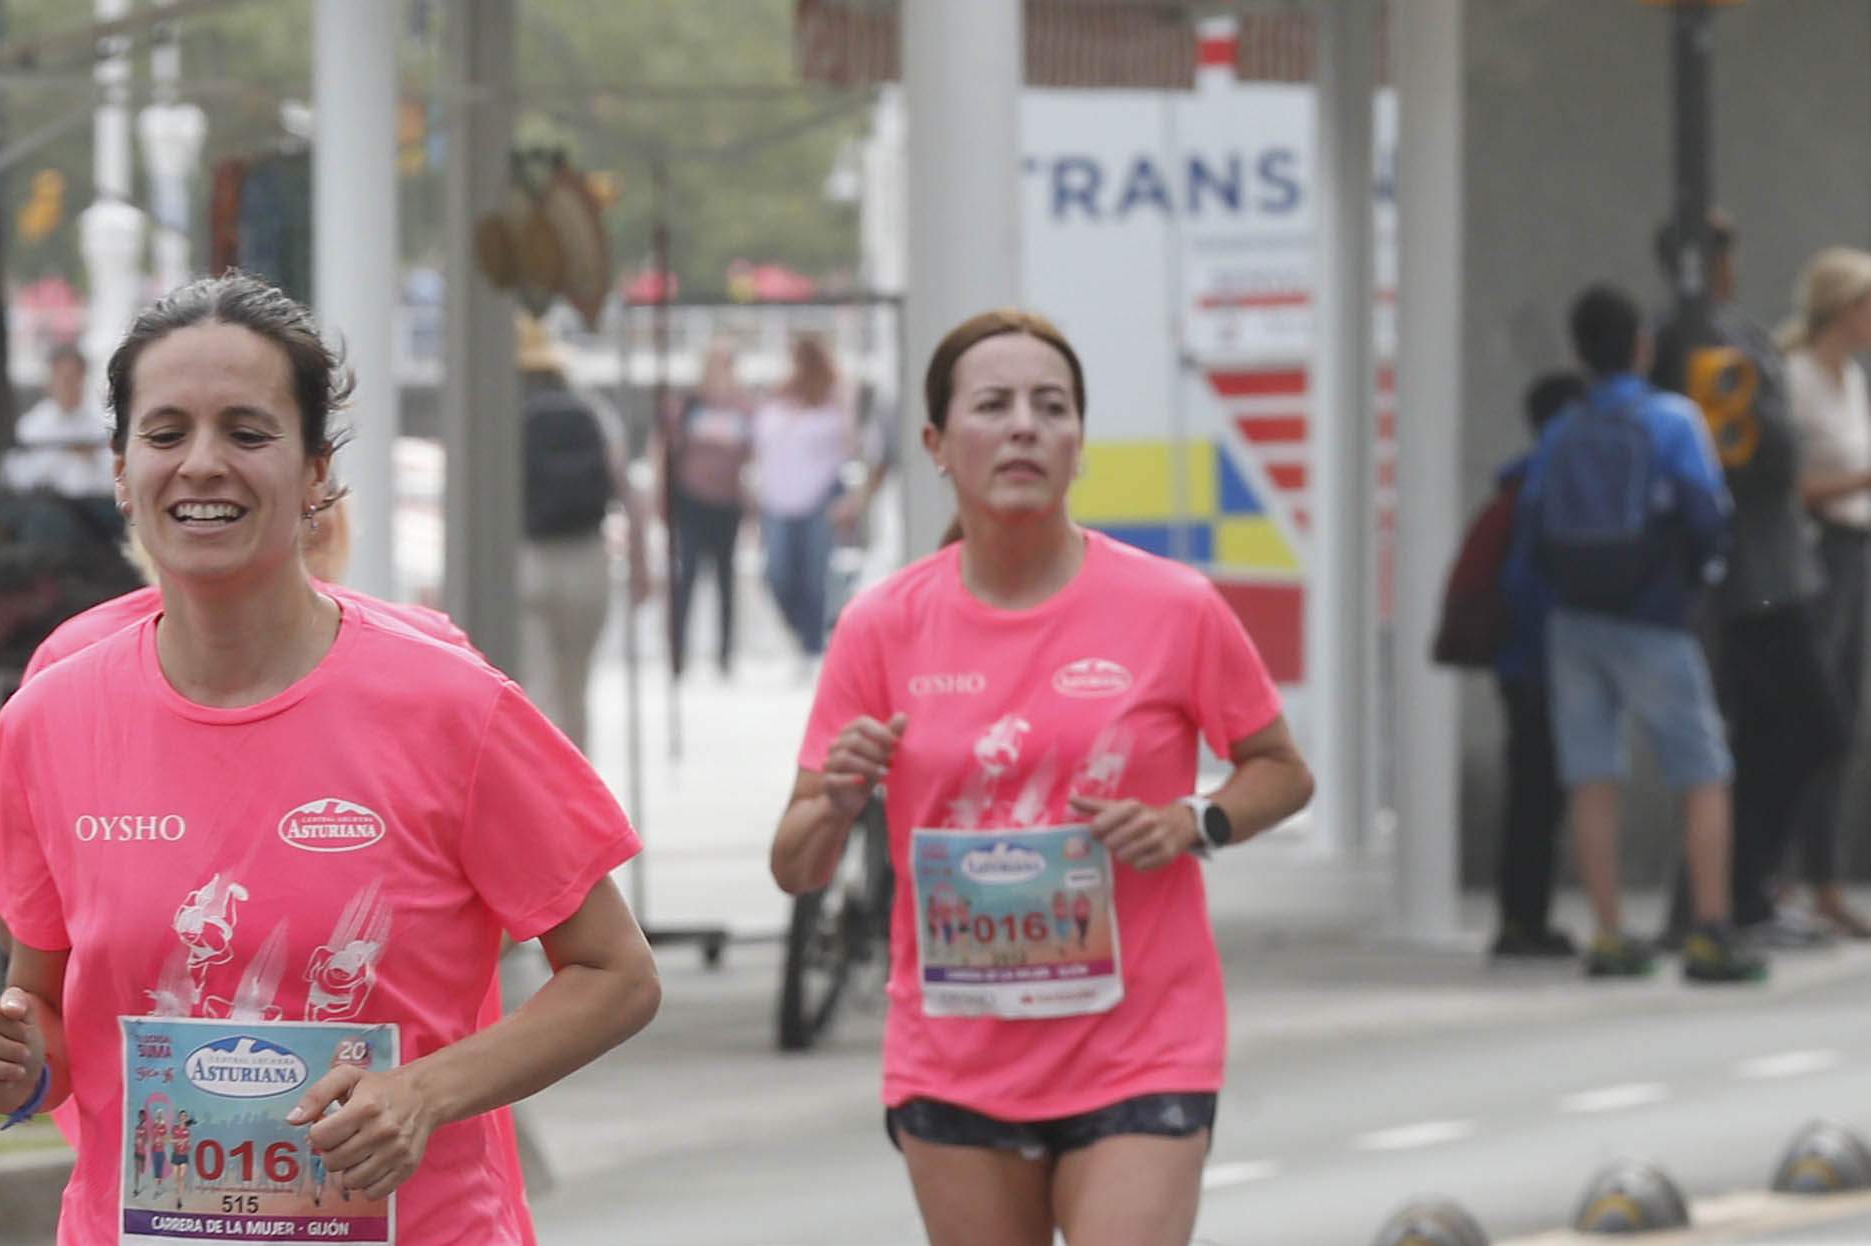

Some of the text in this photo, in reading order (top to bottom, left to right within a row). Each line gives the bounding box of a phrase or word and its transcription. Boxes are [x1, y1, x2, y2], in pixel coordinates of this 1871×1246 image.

[75, 814, 187, 842] OYSHO
[288, 818, 378, 839] ASTURIANA
[973, 911, 1050, 945] 016
[191, 1057, 298, 1083] ASTURIANA
[195, 1138, 300, 1183] 016
[222, 1194, 259, 1213] 515
[151, 1215, 203, 1233] CARRERA
[206, 1218, 223, 1234] DE
[226, 1219, 243, 1234] LA
[245, 1219, 295, 1235] MUJER
[308, 1217, 349, 1236] GIJÓN
